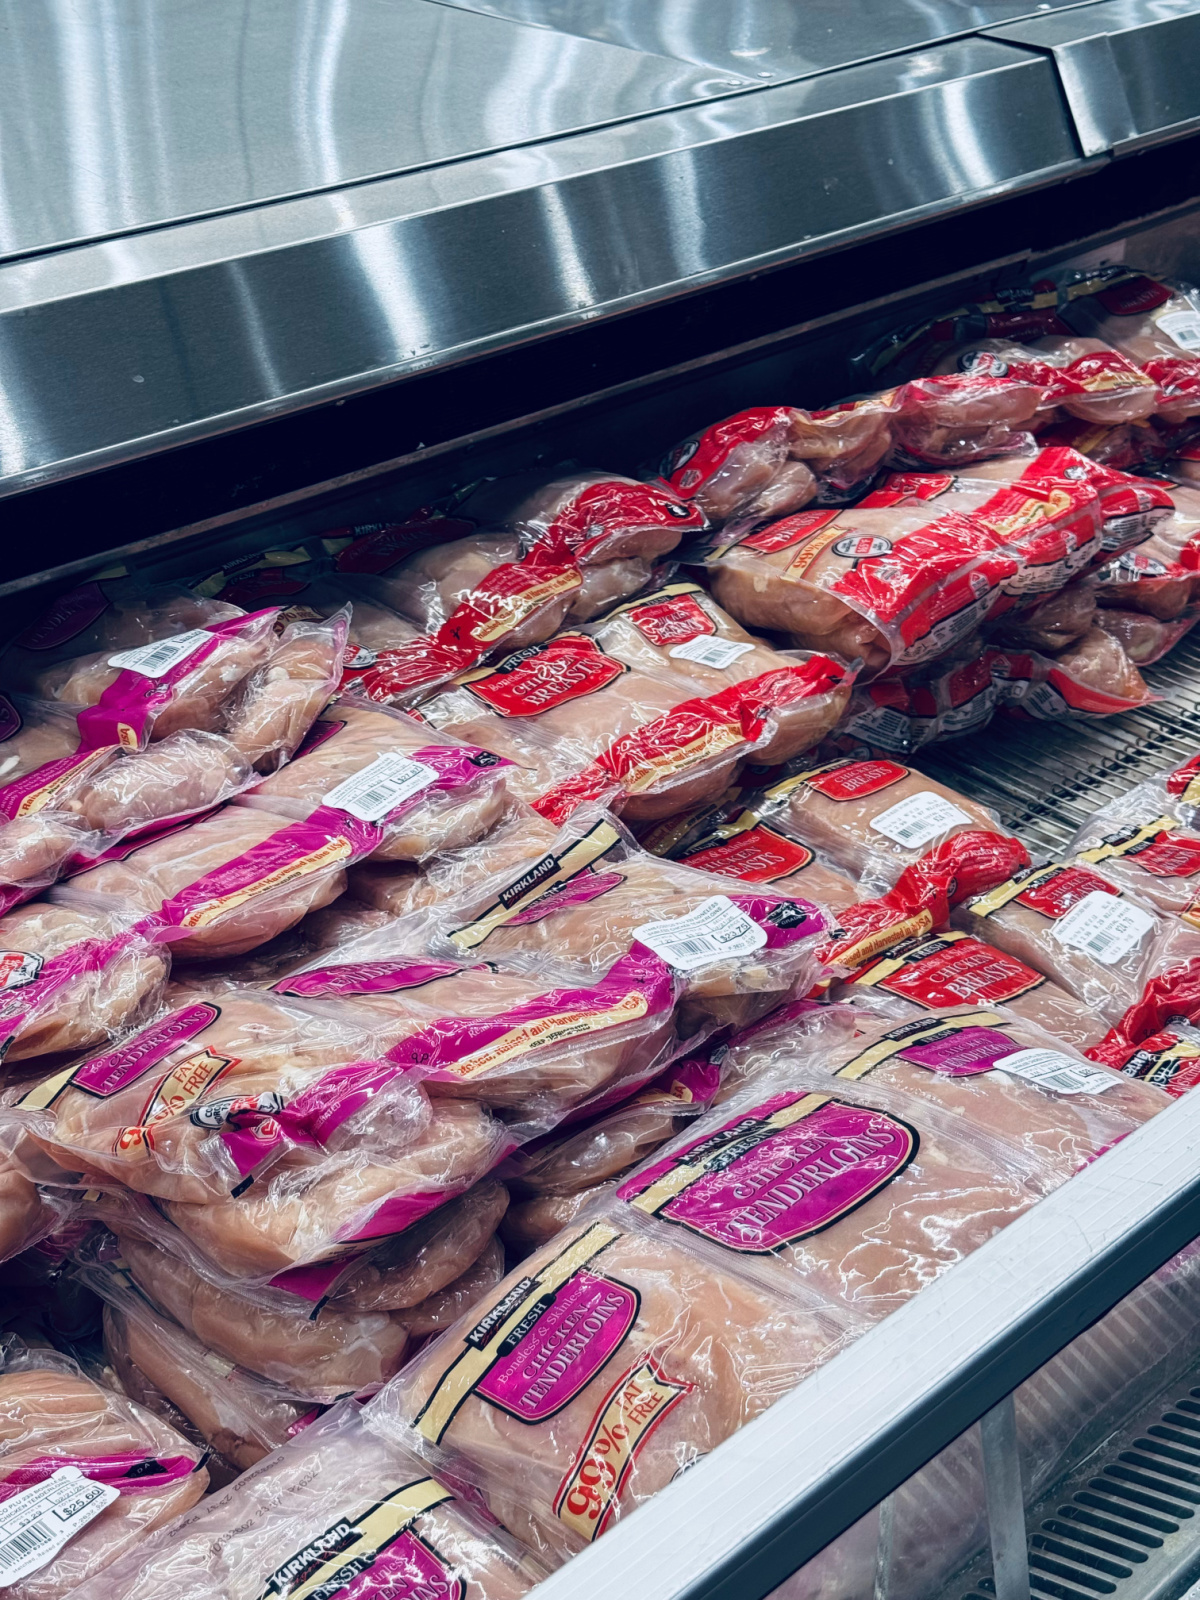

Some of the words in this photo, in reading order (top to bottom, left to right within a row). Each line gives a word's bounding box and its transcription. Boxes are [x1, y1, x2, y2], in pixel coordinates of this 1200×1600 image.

[504, 645, 540, 671] FRESH
[521, 658, 604, 706] BREASTS
[834, 764, 878, 783] CHICKEN
[841, 767, 893, 791] BREASTS
[264, 859, 307, 887] Harvested
[315, 849, 330, 862] the
[327, 838, 348, 853] USA
[698, 846, 762, 872] HICKEN
[714, 851, 785, 879] REASTS
[502, 858, 556, 902] KIRKLAND
[1045, 874, 1091, 900] CHICKEN
[720, 922, 748, 942] $23.75
[861, 944, 874, 956] and
[874, 928, 905, 951] Harvested
[911, 941, 948, 959] FRESH
[929, 952, 996, 983] CHICKEN
[944, 959, 1023, 999] BREASTS
[530, 1020, 550, 1037] and
[886, 1018, 937, 1039] KIRKLAND
[102, 1010, 209, 1091] TENDERLOINS
[173, 1060, 196, 1084] FAT
[183, 1060, 213, 1096] FREE
[679, 1118, 757, 1162] KIRKLAND
[733, 1130, 836, 1200] CHICKEN
[726, 1127, 897, 1241] TENDERLOINS
[470, 1277, 532, 1343] KIRKLAND
[506, 1301, 548, 1346] FRESH
[497, 1333, 541, 1385] Boneless
[538, 1326, 550, 1337] &
[547, 1285, 588, 1326] Skinless
[519, 1292, 626, 1410] TENDERLOINS
[522, 1302, 591, 1380] CHICKEN
[615, 1380, 643, 1411] FAT
[627, 1391, 665, 1425] FREE
[566, 1423, 630, 1520] 99%
[0, 1503, 28, 1522] CHICKEN
[28, 1480, 71, 1505] TENDERLOINS
[8, 1500, 22, 1510] PLU
[19, 1510, 42, 1527] $3.29
[62, 1488, 100, 1516] $25.60
[272, 1523, 351, 1588] KIRKLAND
[311, 1561, 364, 1600] FRESH
